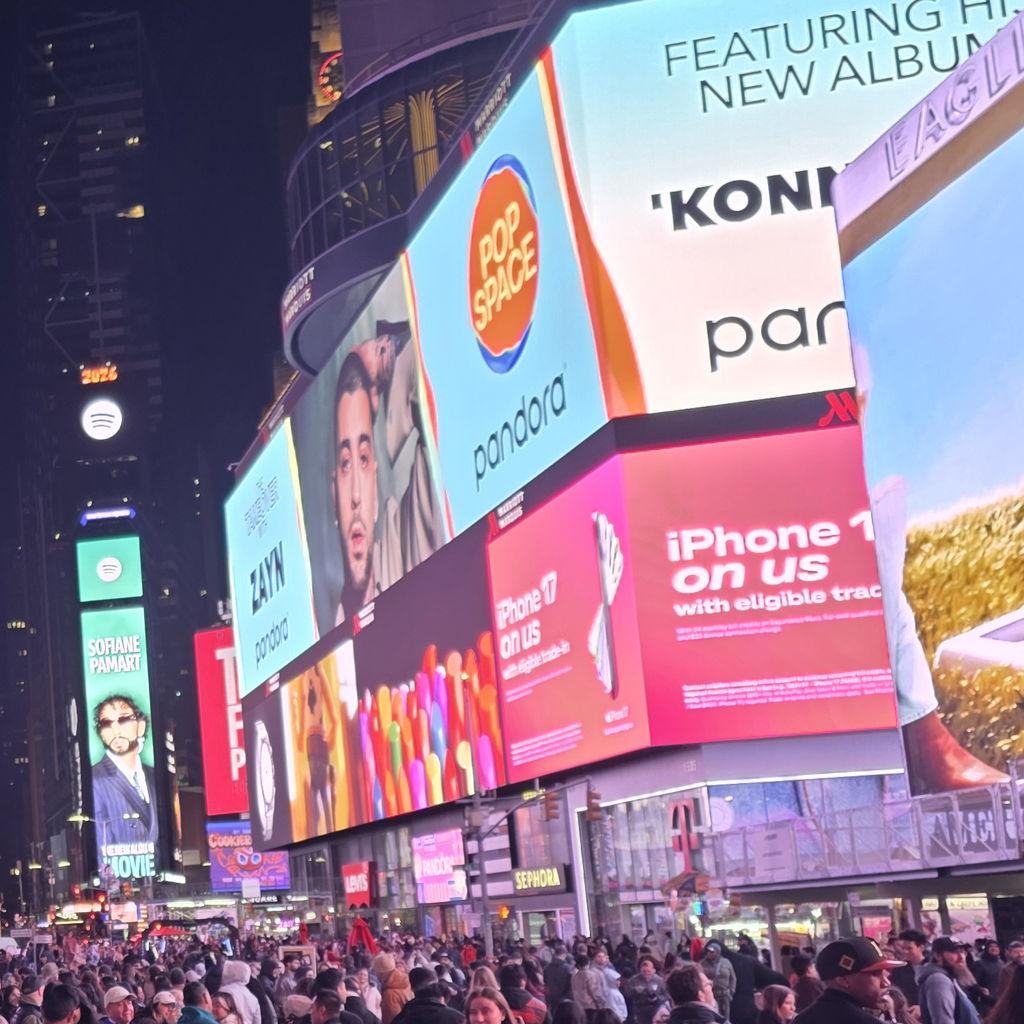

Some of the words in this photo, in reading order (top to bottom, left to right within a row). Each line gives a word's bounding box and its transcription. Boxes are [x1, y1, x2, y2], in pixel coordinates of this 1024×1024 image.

[664, 0, 942, 76] FEATURING
[961, 0, 1020, 25] HI
[700, 61, 816, 113] NEW
[479, 201, 520, 279] POP
[473, 231, 537, 331] SPACE
[473, 372, 567, 492] pandora
[666, 521, 841, 562] iPhone
[249, 541, 285, 616] ZAYN
[672, 560, 745, 594] on
[761, 553, 830, 585] us
[496, 596, 542, 631] iPhone
[541, 571, 557, 605] 17
[673, 598, 730, 617] with
[735, 589, 826, 615] eligible
[87, 635, 140, 657] SOFIANE
[89, 654, 141, 674] PAMART
[255, 616, 289, 669] pandora
[500, 630, 521, 660] on
[521, 619, 542, 650] us
[515, 867, 560, 890] SEPHORA
